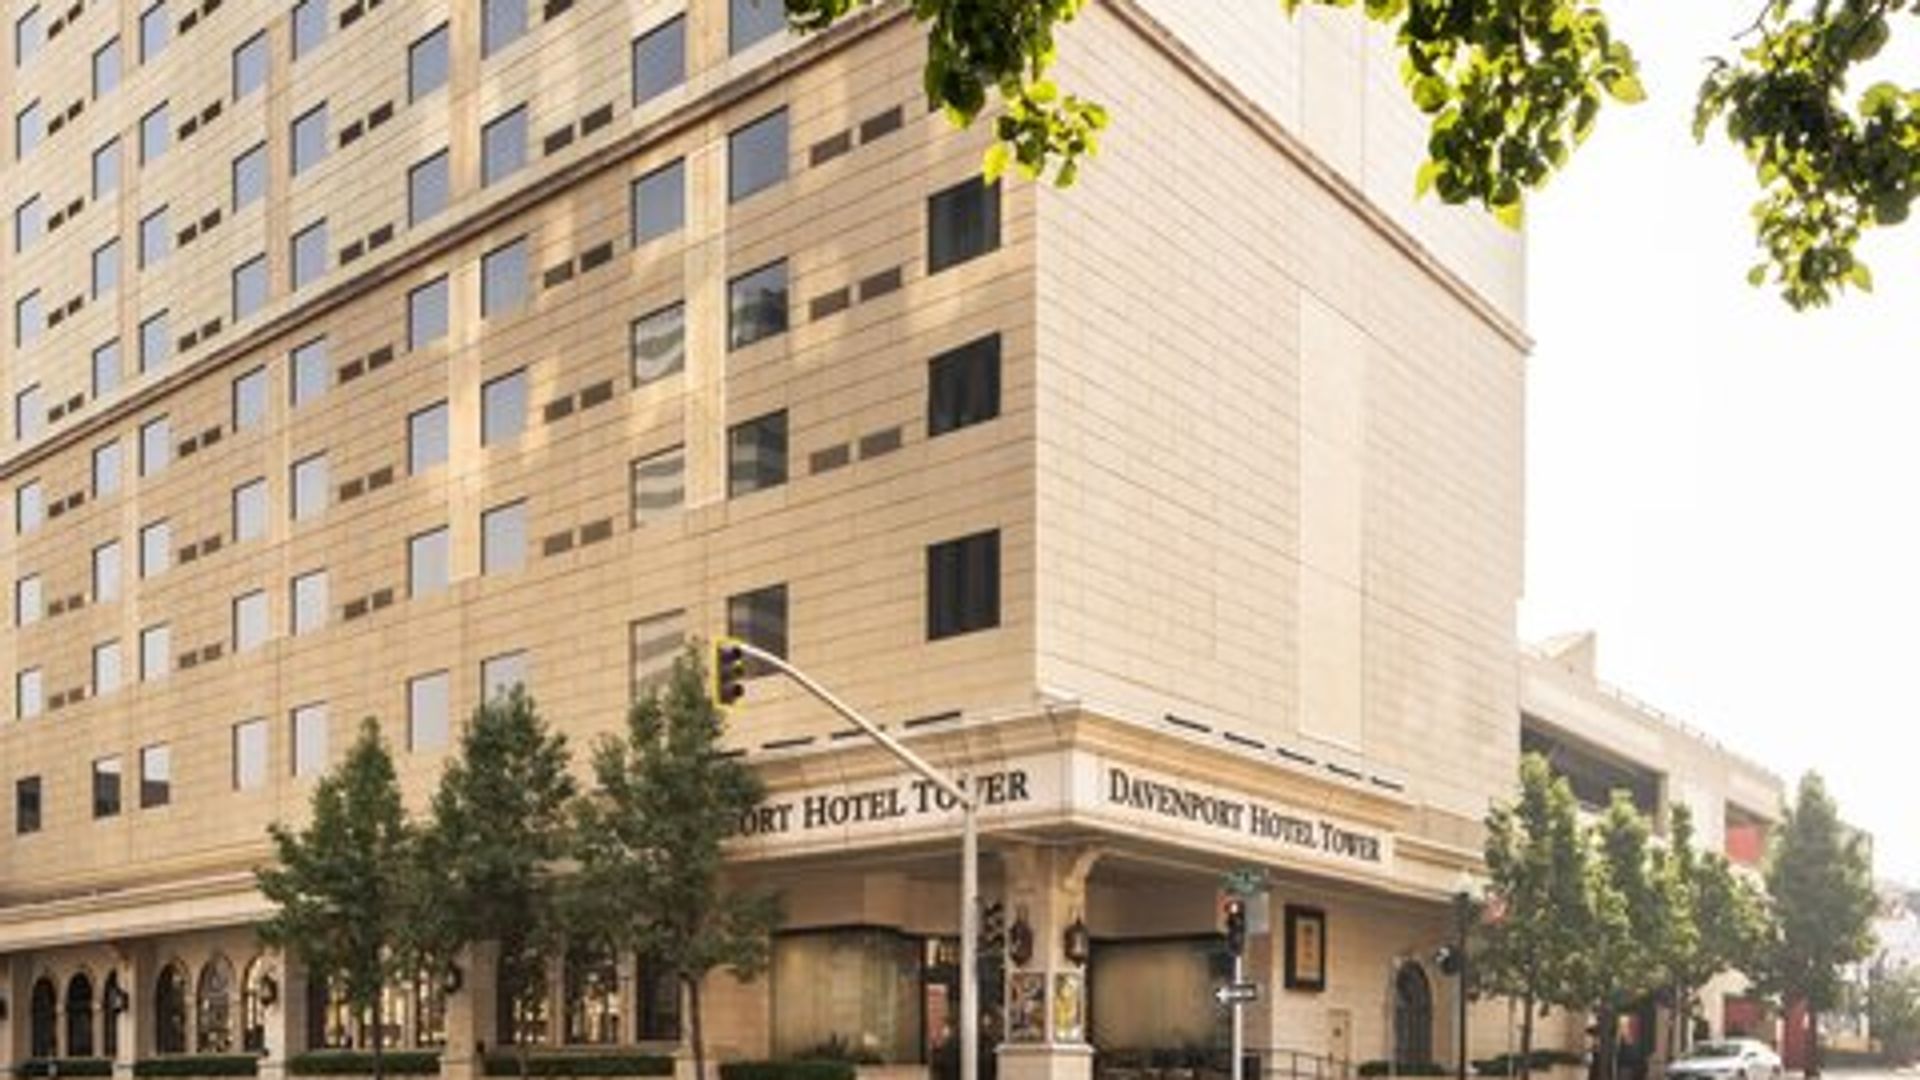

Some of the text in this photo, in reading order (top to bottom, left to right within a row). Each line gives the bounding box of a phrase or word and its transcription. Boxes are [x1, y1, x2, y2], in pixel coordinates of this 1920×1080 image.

[803, 788, 905, 828] HOTEL
[1108, 768, 1381, 861] DAVENPORT HOTEL TOWER
